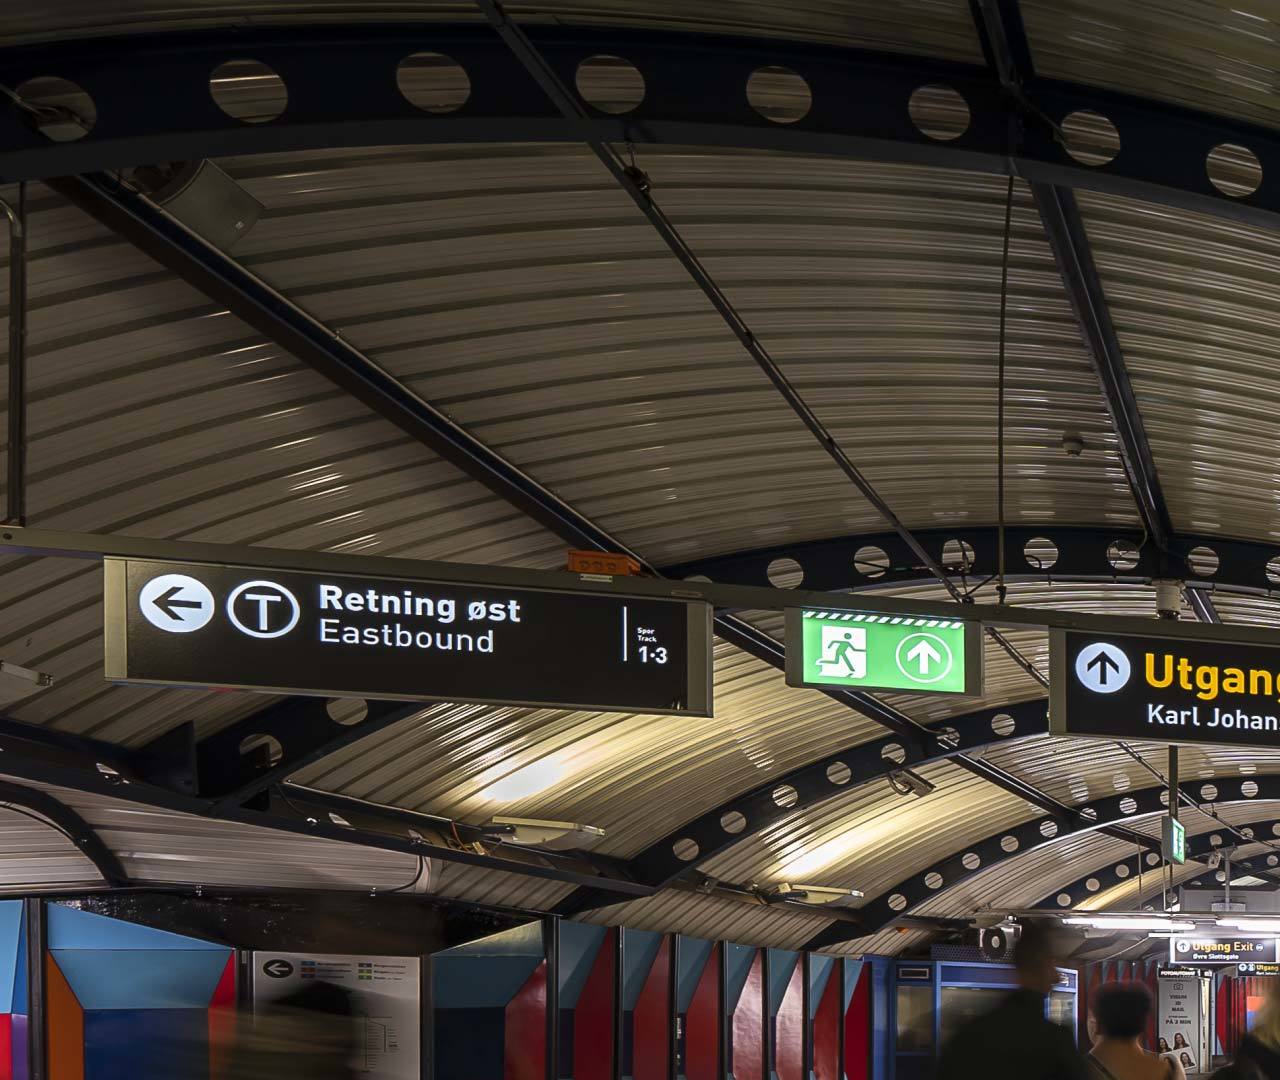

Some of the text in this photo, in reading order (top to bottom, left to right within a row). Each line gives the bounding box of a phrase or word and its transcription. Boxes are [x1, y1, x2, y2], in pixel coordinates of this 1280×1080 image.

[320, 585, 520, 623] Retning øst
[320, 619, 494, 653] Eastbound
[637, 627, 655, 635] Spor
[1147, 704, 1200, 727] Karl
[1193, 942, 1254, 953] Utgang Exit
